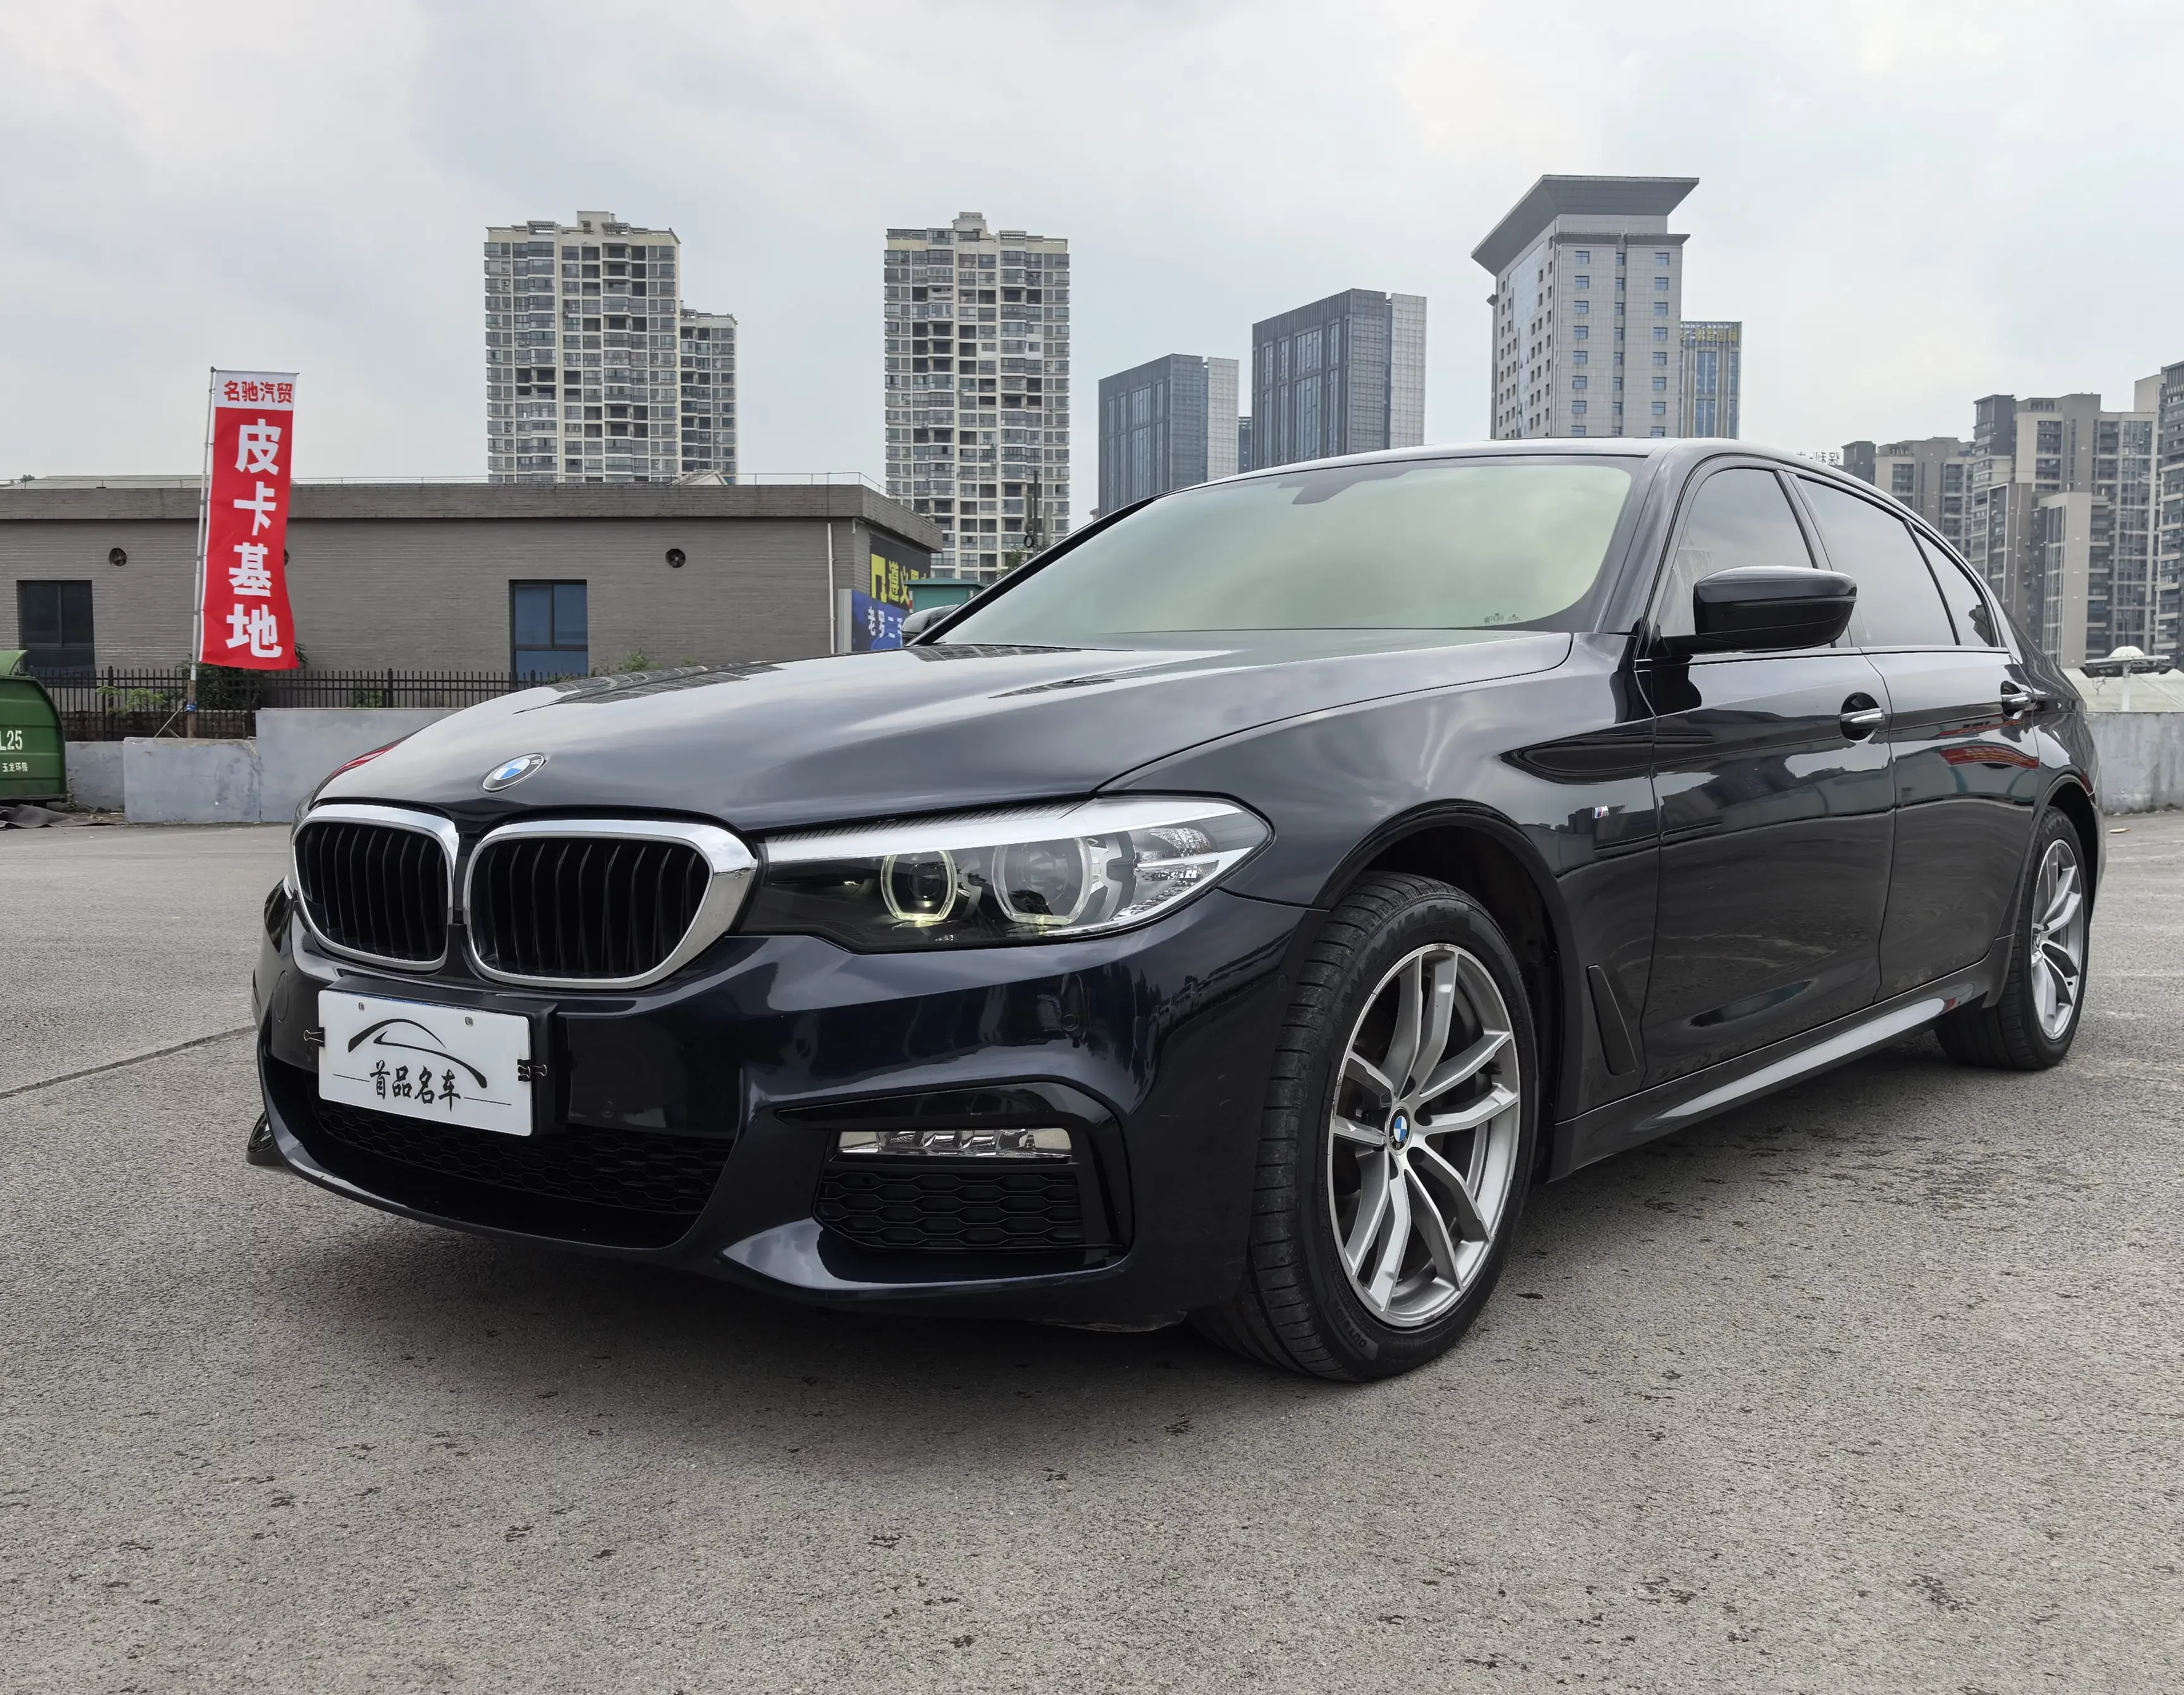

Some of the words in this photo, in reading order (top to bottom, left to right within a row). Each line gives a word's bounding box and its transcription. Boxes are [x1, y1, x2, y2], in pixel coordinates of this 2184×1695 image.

[223, 380, 293, 403] 名驰汽贸
[226, 419, 283, 658] 皮卡基地
[369, 1060, 461, 1112] 首品名车
